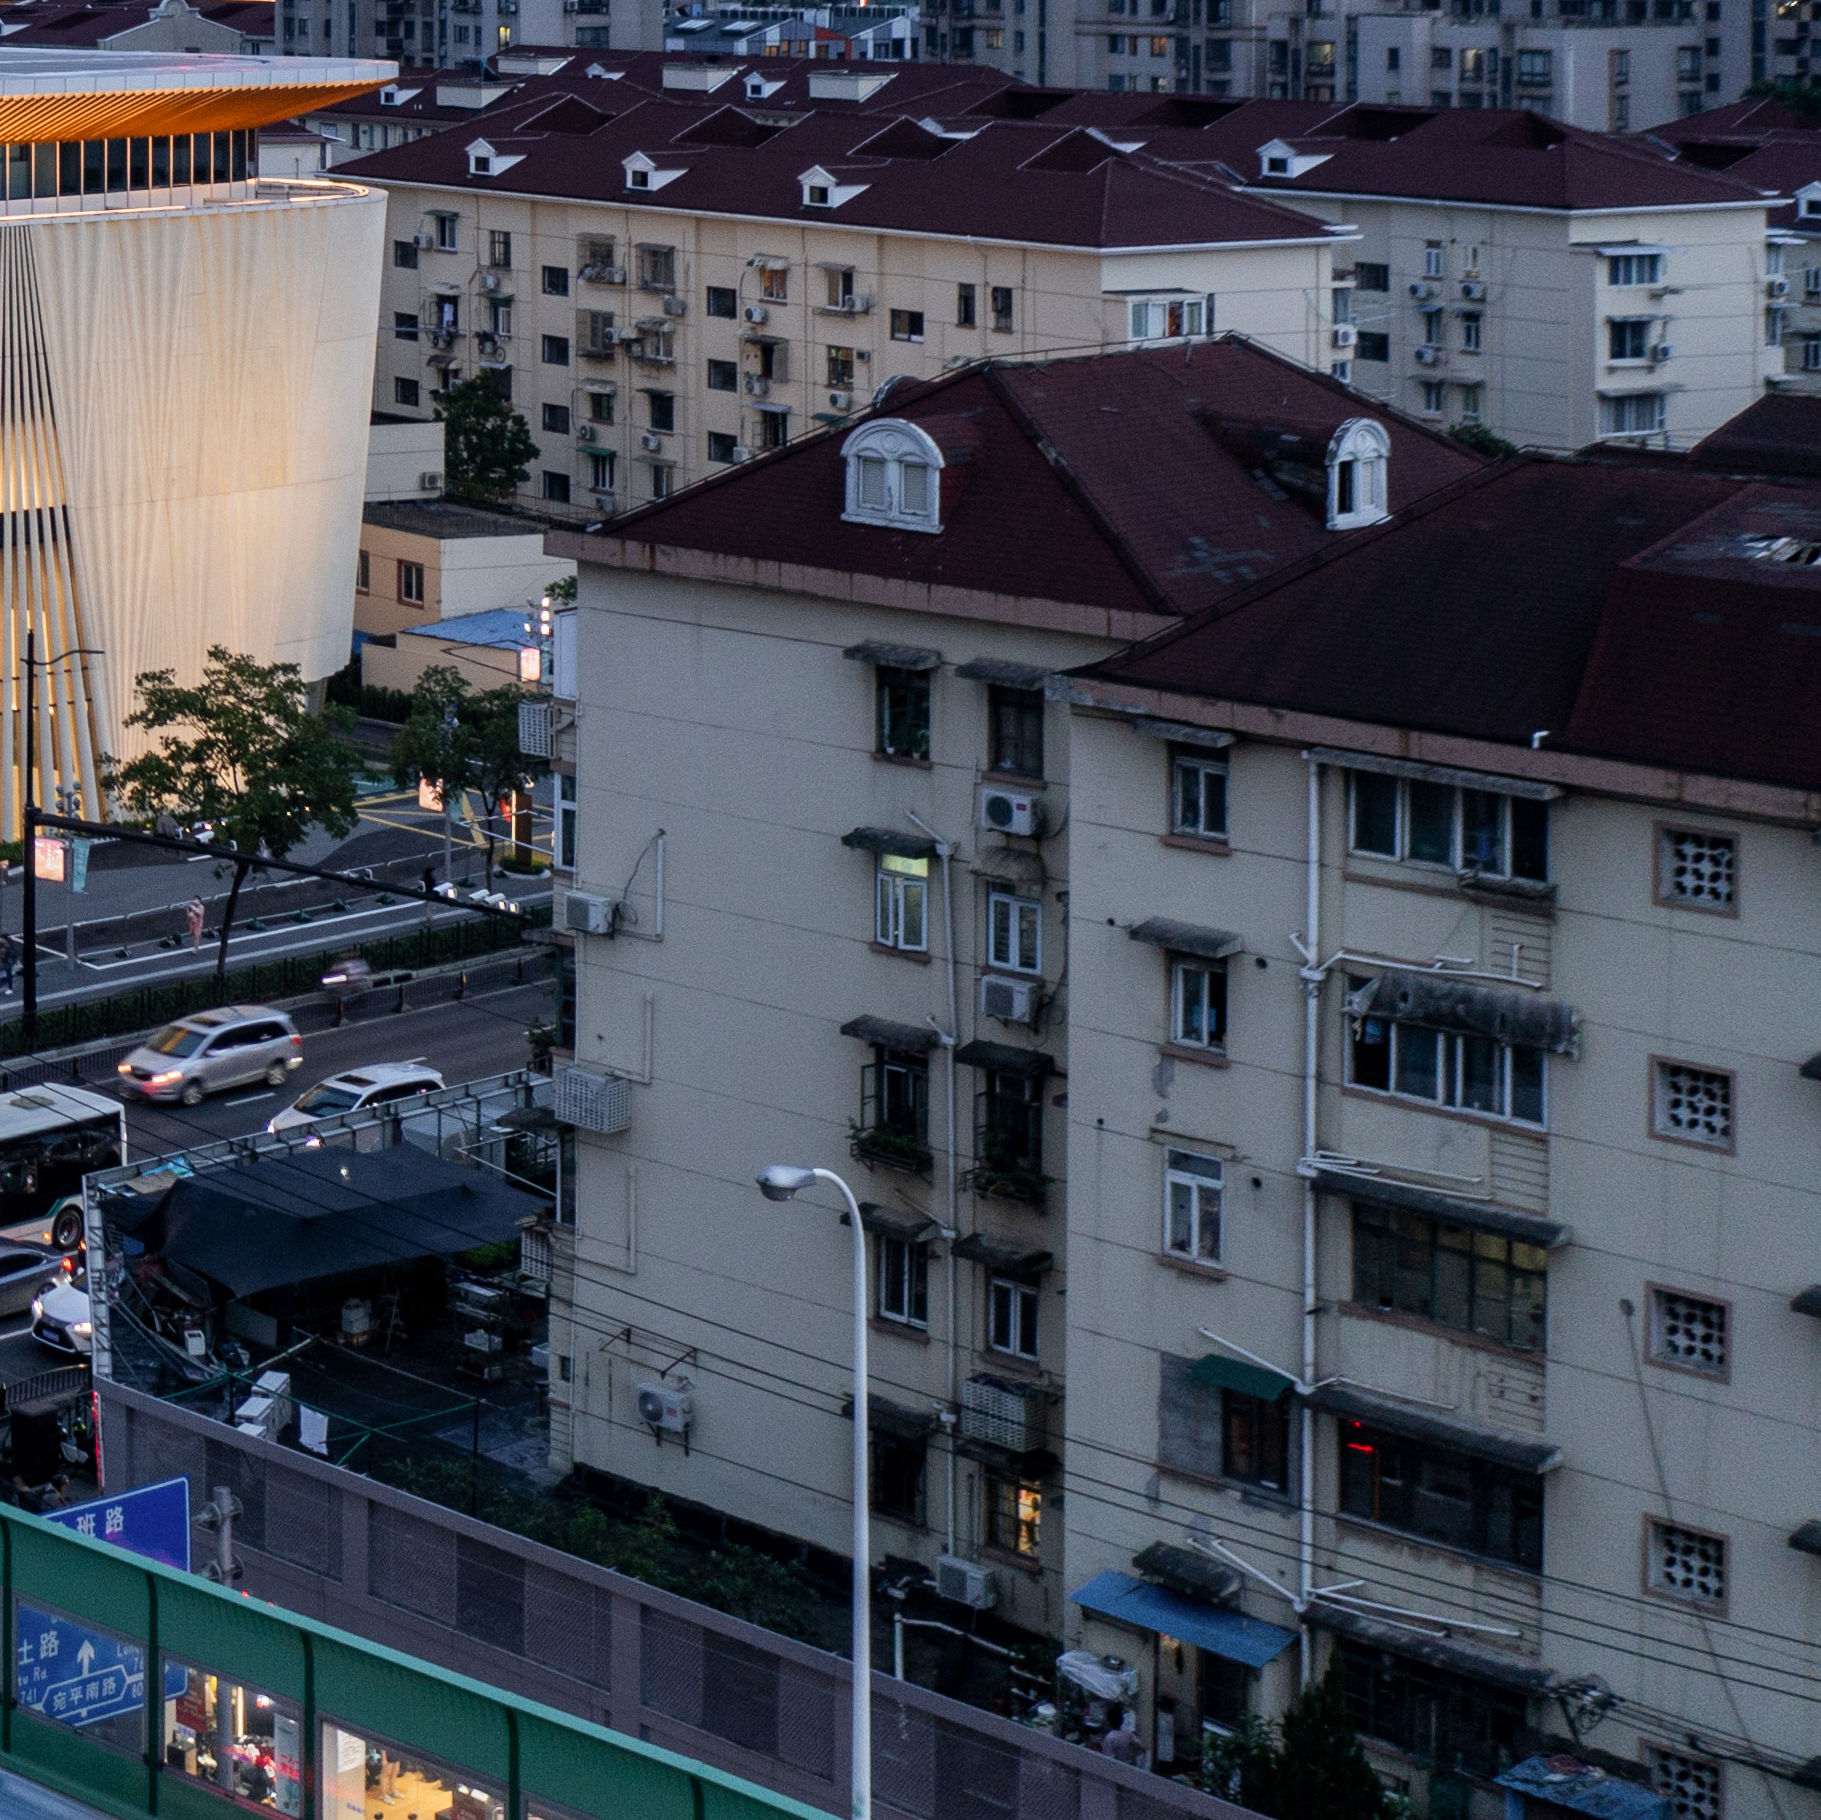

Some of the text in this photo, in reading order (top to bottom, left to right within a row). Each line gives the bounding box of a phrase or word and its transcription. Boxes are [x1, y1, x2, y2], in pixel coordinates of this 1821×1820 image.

[57, 1506, 125, 1538] 班路
[52, 1676, 117, 1711] 宛平南路
